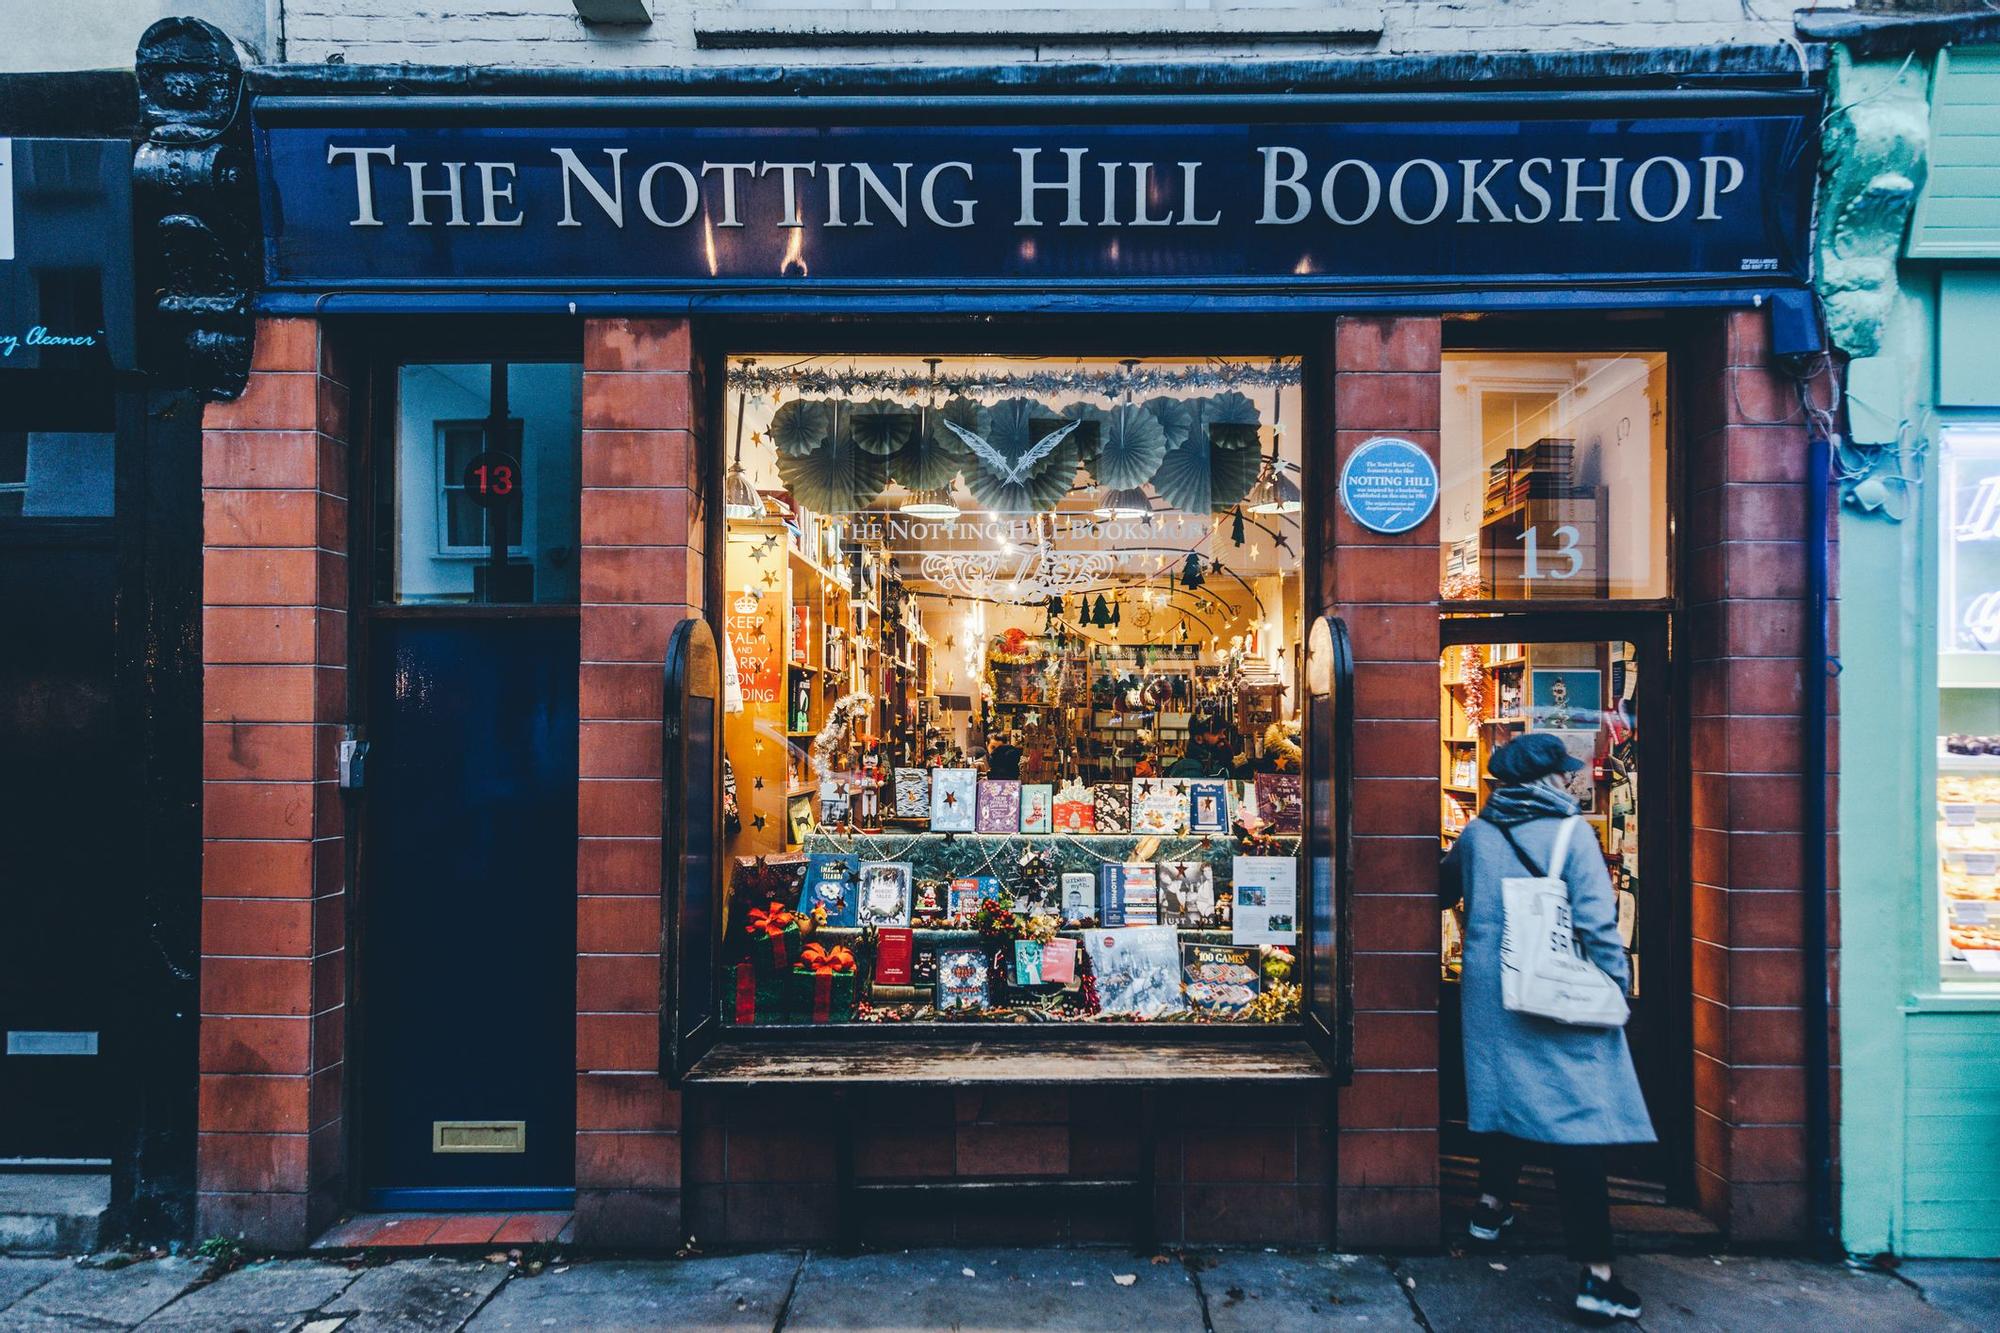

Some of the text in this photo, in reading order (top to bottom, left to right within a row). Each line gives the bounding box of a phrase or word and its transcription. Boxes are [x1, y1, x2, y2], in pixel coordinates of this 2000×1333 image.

[327, 143, 1745, 229] THE NOTTING HILL BOOKSHOP
[26, 326, 96, 346] Cleaner
[473, 465, 513, 495] 13
[1348, 476, 1432, 486] NOTTING HILL
[1515, 525, 1584, 580] 13
[727, 615, 765, 629] KEEP
[736, 646, 753, 654] AND
